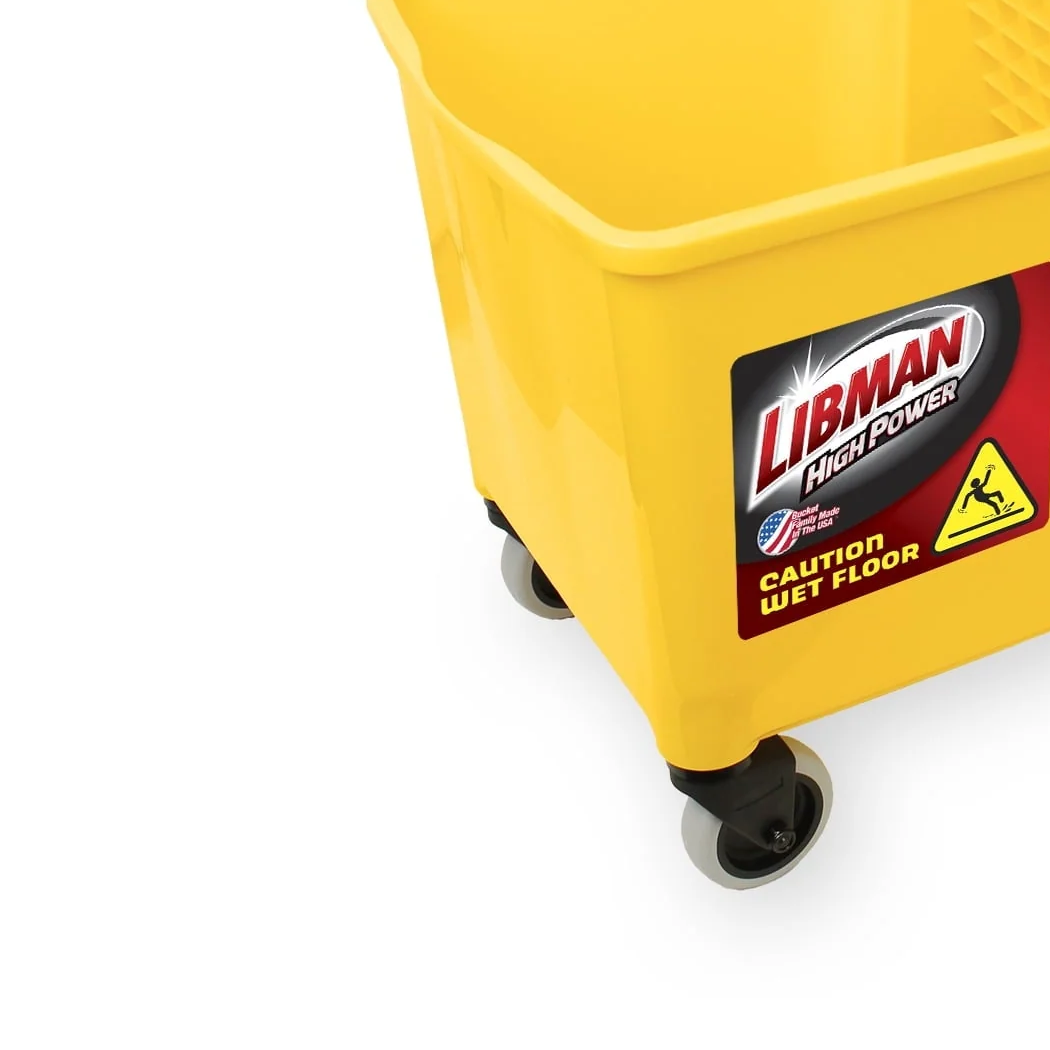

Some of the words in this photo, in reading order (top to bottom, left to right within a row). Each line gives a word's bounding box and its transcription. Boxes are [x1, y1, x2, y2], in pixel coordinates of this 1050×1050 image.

[756, 314, 967, 496] LIBMAN
[804, 435, 868, 495] HIGH
[869, 379, 958, 449] POWER
[802, 525, 816, 536] The
[817, 517, 833, 530] USA
[818, 506, 840, 520] Made
[760, 577, 824, 615] WET
[832, 543, 920, 590] FLOOR
